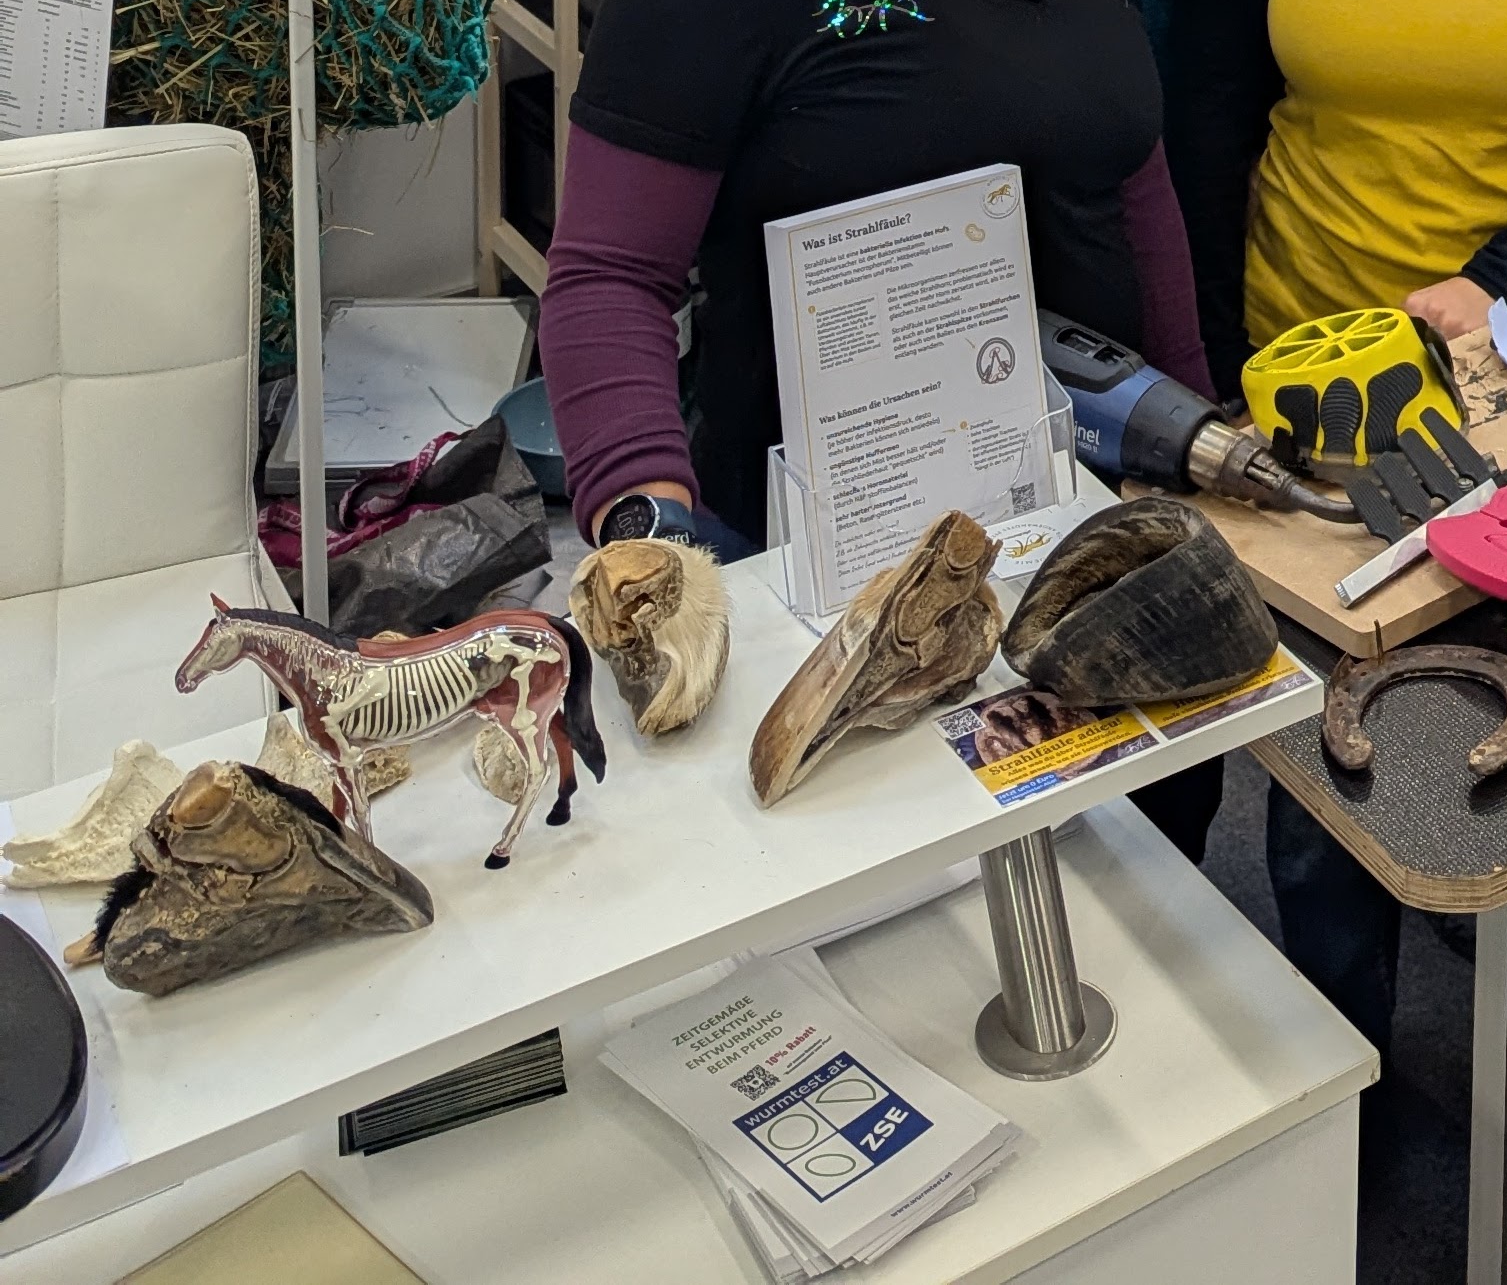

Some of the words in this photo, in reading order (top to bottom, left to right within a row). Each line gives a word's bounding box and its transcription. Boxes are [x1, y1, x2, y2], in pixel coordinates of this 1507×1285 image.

[802, 238, 825, 250] Was
[829, 233, 843, 244] ist
[845, 213, 911, 240] Strahlfäule?
[819, 415, 836, 424] Was
[837, 405, 867, 419] können
[869, 400, 881, 409] die
[883, 389, 920, 405] Ursachen
[922, 381, 941, 394] sein?
[989, 737, 1076, 775] Strahlfäule
[1078, 717, 1122, 740] adieu!
[1008, 766, 1026, 776] Alles
[1028, 759, 1043, 767] was
[1056, 746, 1074, 756] über
[999, 790, 1016, 799] Jetzt
[1018, 784, 1029, 793] um
[1036, 774, 1055, 786] Euro
[1001, 773, 1028, 786] wissen
[685, 1009, 783, 1070] ENTWURMUNG
[690, 1009, 757, 1051] SELEKTIVE
[707, 1053, 741, 1075] BEIM
[740, 1026, 783, 1055] PFERD
[765, 1050, 788, 1066] 10%
[786, 1026, 816, 1051] Rabatt
[744, 1058, 848, 1126] wurmtest.at
[859, 1106, 909, 1152] ZSE
